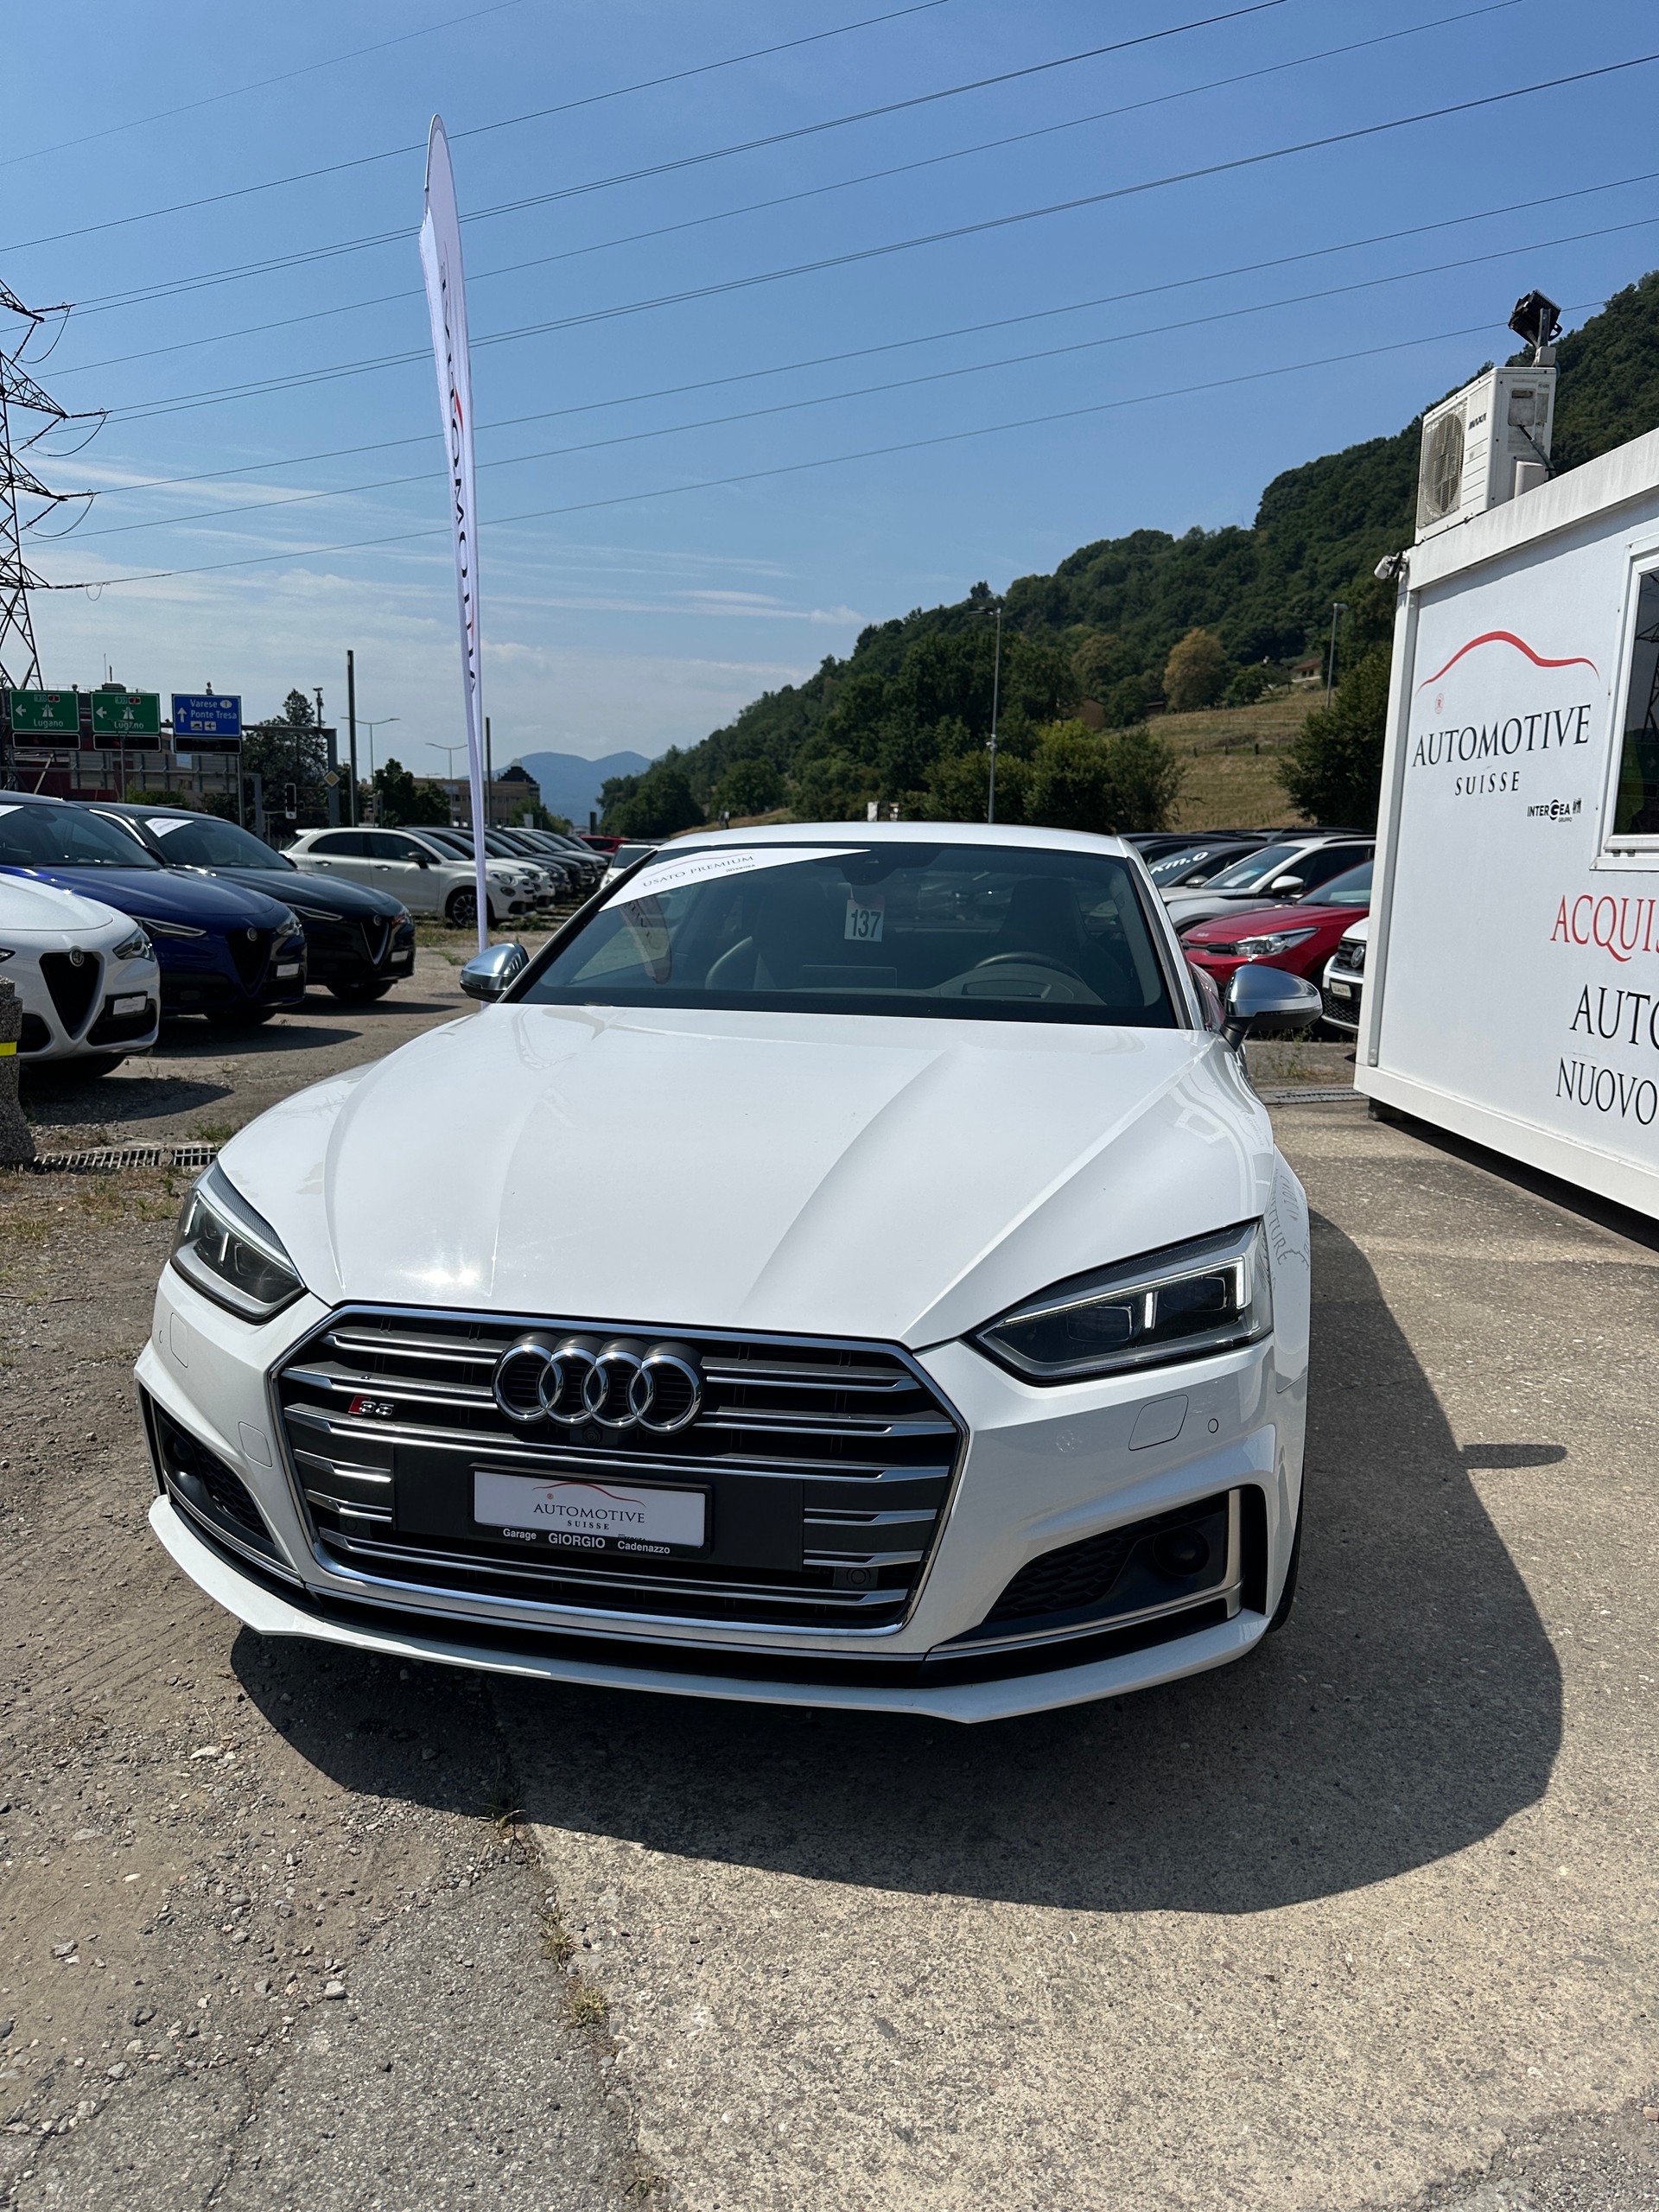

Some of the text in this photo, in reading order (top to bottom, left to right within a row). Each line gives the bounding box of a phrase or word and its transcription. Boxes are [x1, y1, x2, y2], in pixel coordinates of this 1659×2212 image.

[189, 698, 218, 709] Varese
[190, 709, 238, 720] Ponte Tresa
[33, 718, 64, 729] Lugano
[1411, 703, 1592, 767] AUTOMOTIVE
[1454, 771, 1520, 796] SUISSE
[643, 871, 686, 887] USATO
[690, 855, 754, 874] PREMIUM
[850, 908, 882, 938] 137
[1550, 893, 1659, 963] ACQUI
[1555, 1056, 1657, 1125] NUOVO
[532, 1503, 645, 1523] AUTOMOTIVE
[567, 1520, 610, 1530] SUISSE
[503, 1528, 537, 1541] Garage
[548, 1532, 606, 1549] GIORGIO
[617, 1541, 671, 1554] Cadenazzo
